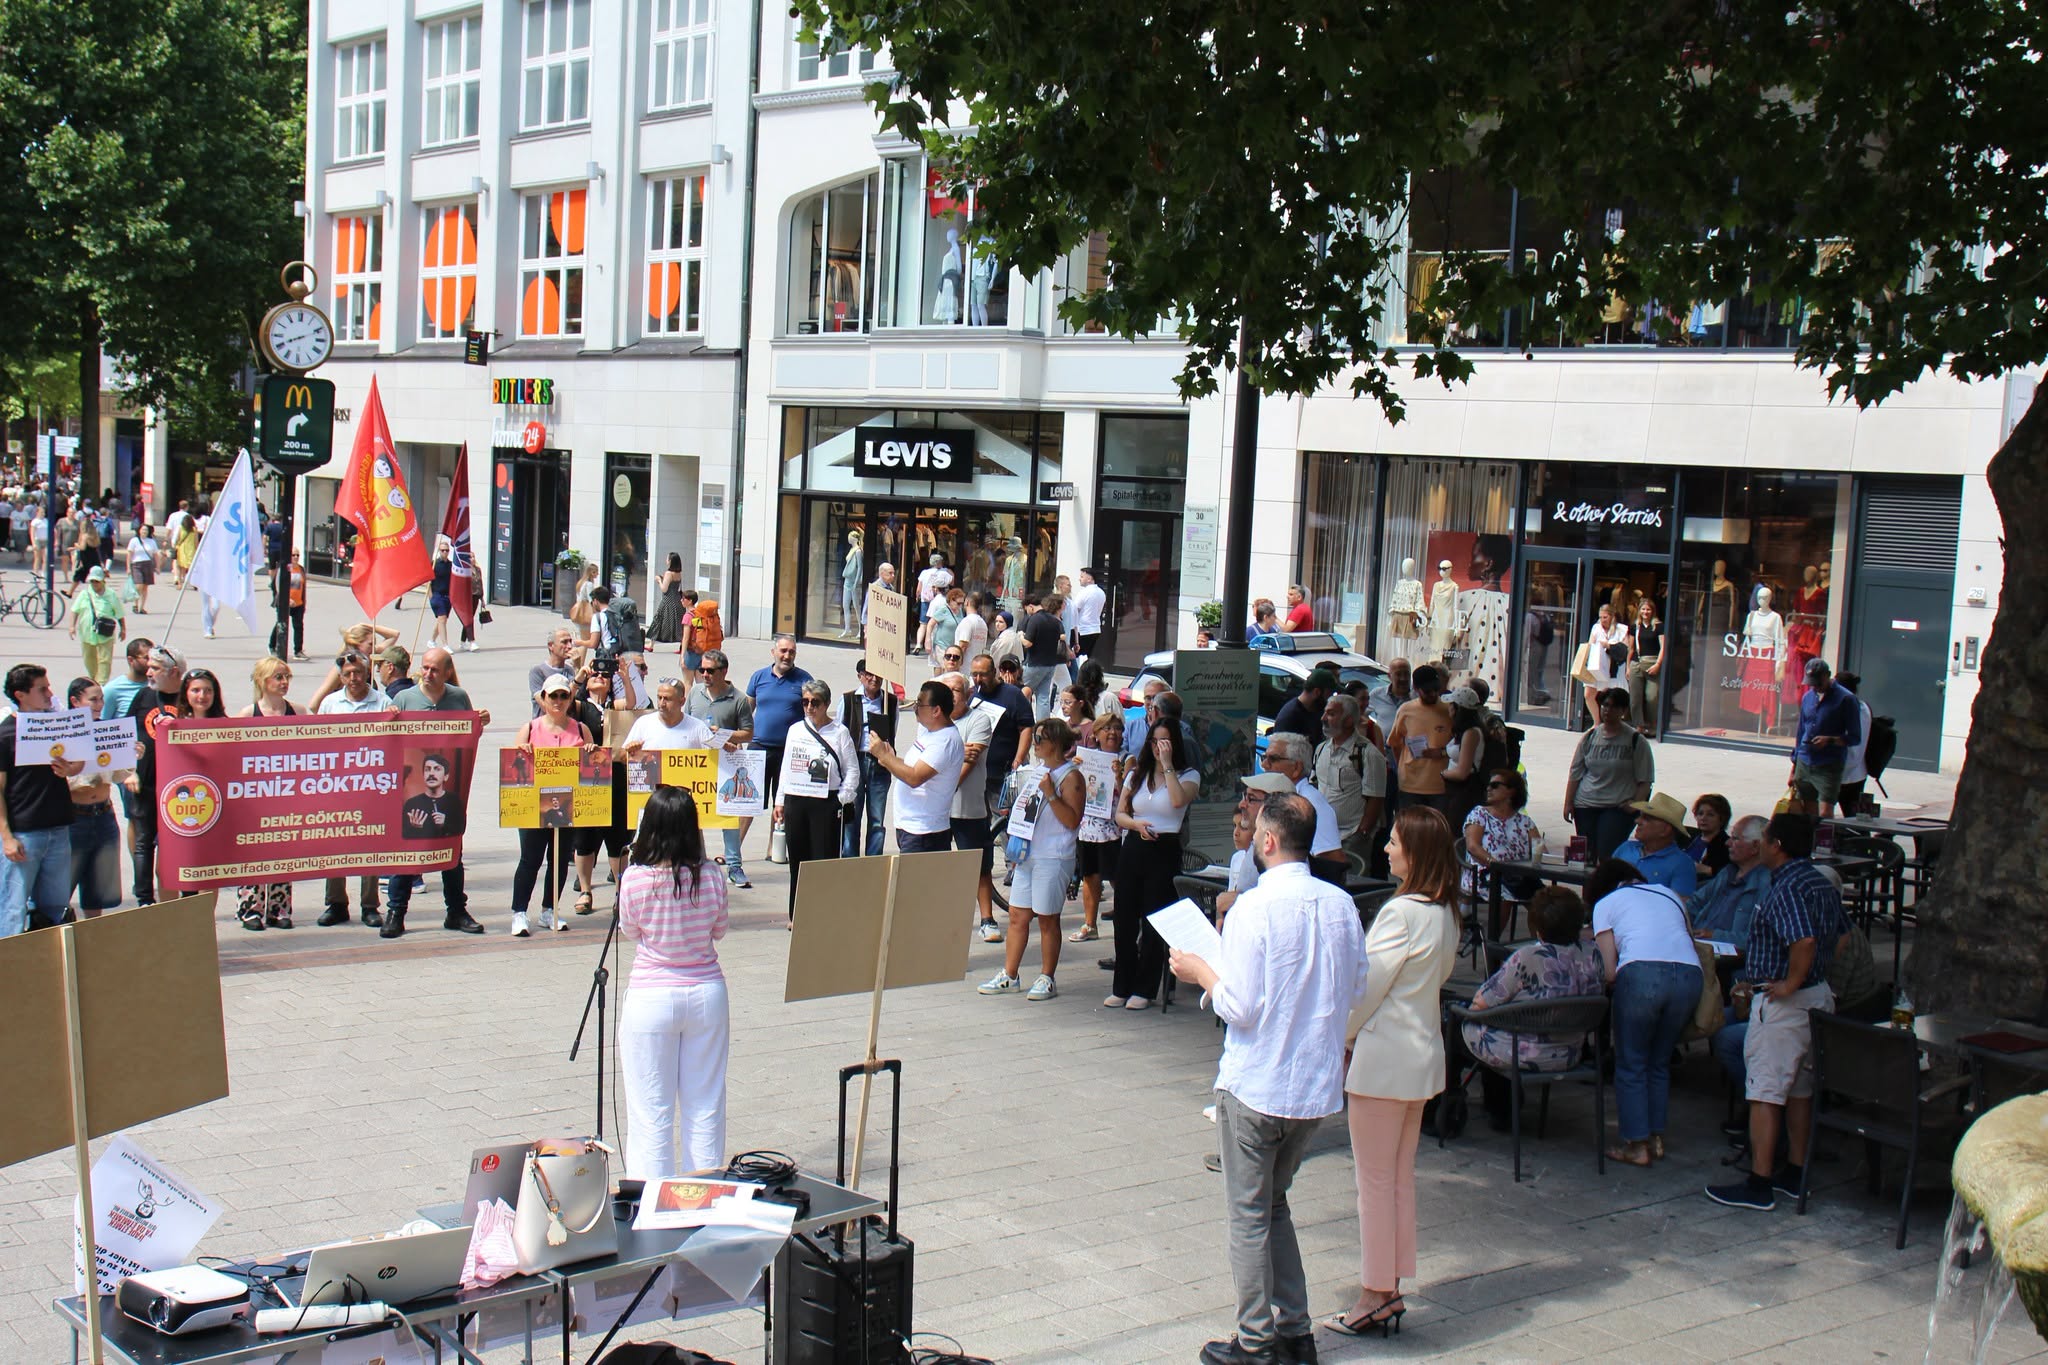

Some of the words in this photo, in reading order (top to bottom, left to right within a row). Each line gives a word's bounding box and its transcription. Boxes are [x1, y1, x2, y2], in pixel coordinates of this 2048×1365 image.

[493, 378, 555, 405] BUTLERS
[284, 440, 300, 449] 200
[1195, 512, 1205, 521] 30
[1553, 501, 1568, 522] &
[1569, 502, 1610, 524] other
[1610, 503, 1663, 528] Stories
[872, 589, 885, 602] TEK
[1969, 589, 1983, 598] 28
[1722, 633, 1788, 661] SALE
[27, 717, 54, 725] Finger
[172, 729, 213, 743] Finger
[216, 729, 242, 742] weg
[245, 728, 269, 738] von
[271, 726, 293, 737] der
[295, 725, 337, 736] Kunst-
[338, 723, 361, 734] und
[363, 721, 469, 736] Meinungsfreiheit!
[241, 753, 340, 775] FREIHEIT
[344, 747, 385, 769] FÜR
[668, 754, 708, 768] DENİZ
[226, 776, 296, 800] DENİZ
[300, 772, 398, 797] GÖKTAŞ!
[175, 804, 207, 816] DIDF
[260, 812, 303, 829] DENİZ
[305, 809, 363, 826] GÖKTAŞ
[236, 831, 299, 846] SERBEST
[302, 824, 386, 841] BIRAKILSIN!
[183, 866, 220, 879] Sanat
[223, 866, 238, 875] ve
[240, 861, 271, 874] ifade
[273, 854, 363, 872] özgürlüğünden
[366, 851, 417, 864] ellerinizi
[419, 849, 452, 865] çekin!
[108, 1251, 127, 1264] hier
[106, 1263, 117, 1271] zu
[128, 1259, 141, 1270] ist
[96, 1267, 109, 1277] od
[118, 1267, 135, 1277] cht
[378, 1266, 398, 1280] hp
[102, 1282, 115, 1294] Zu
